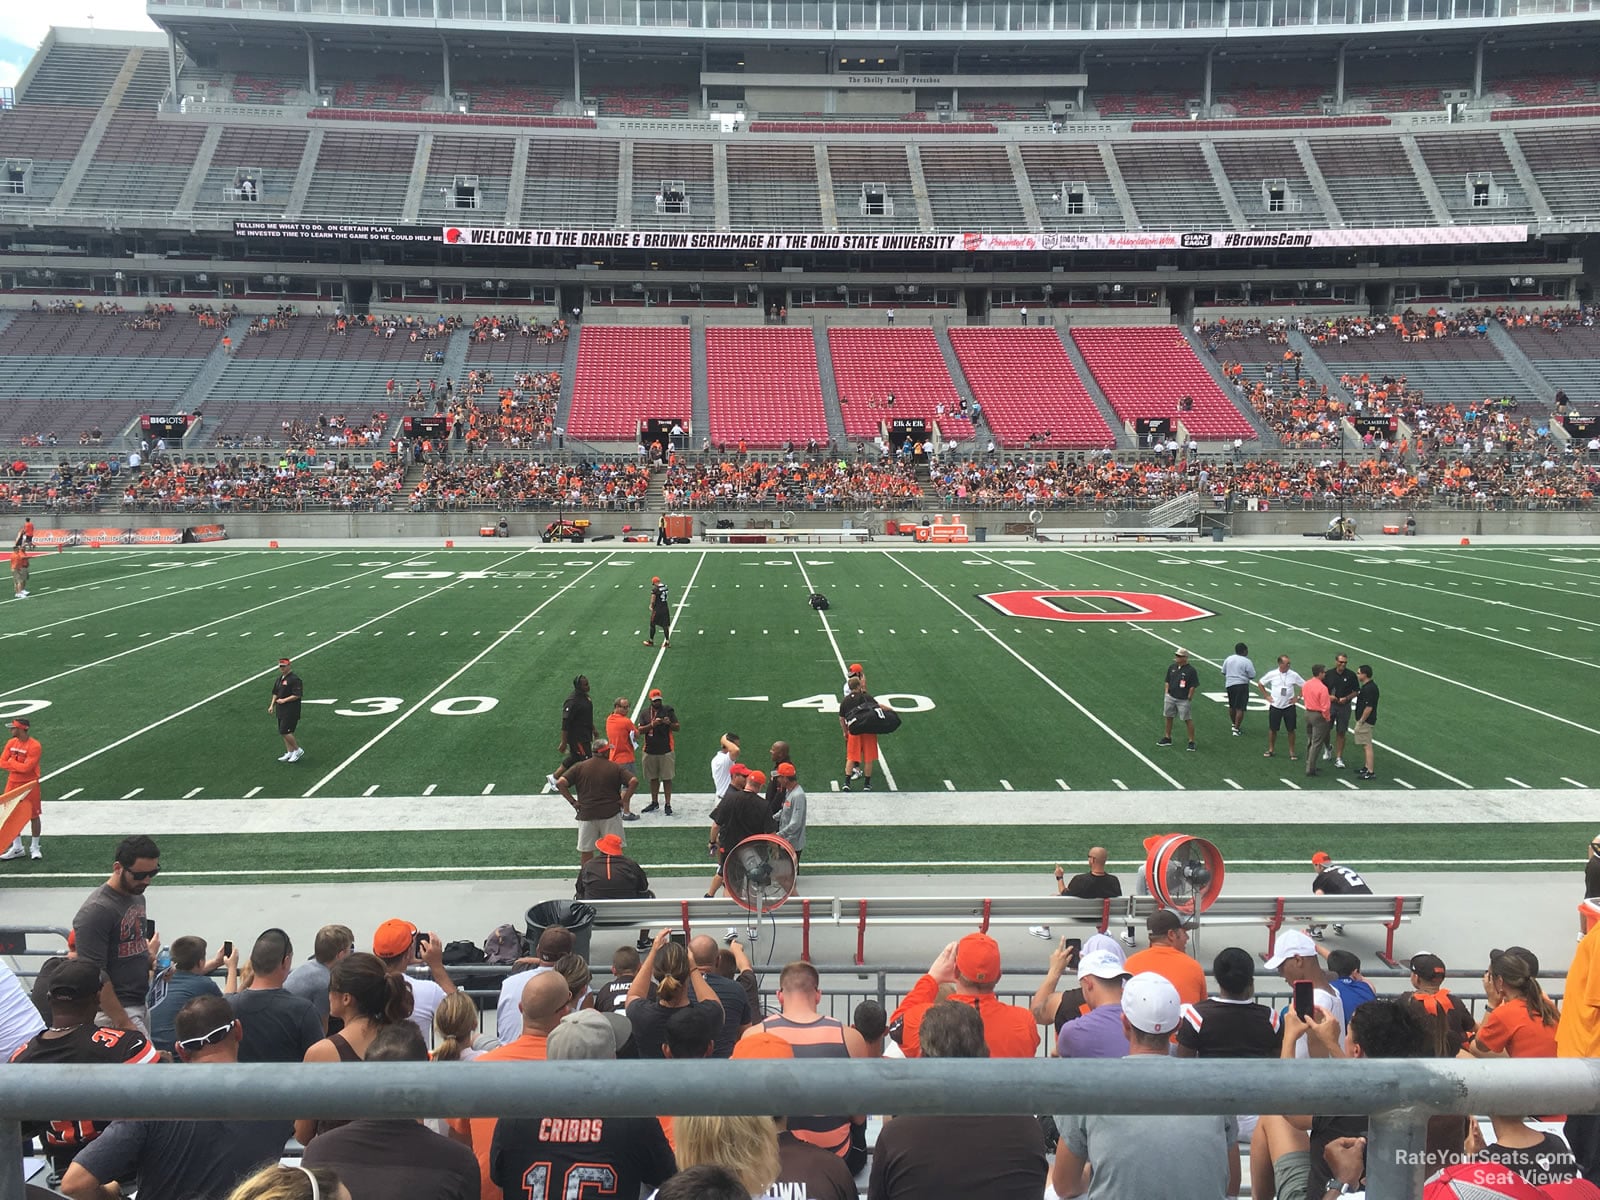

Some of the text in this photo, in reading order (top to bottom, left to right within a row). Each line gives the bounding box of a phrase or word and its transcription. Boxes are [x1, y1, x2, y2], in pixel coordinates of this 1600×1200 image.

[887, 76, 909, 84] Family
[471, 230, 531, 244] WELCOME
[536, 231, 551, 245] TO
[555, 231, 577, 246] THE
[581, 232, 629, 246] ORANGE
[632, 233, 641, 247] &
[643, 233, 688, 247] BROWN
[691, 234, 764, 248] SCRIMMAGE
[766, 235, 782, 249] AT
[786, 235, 807, 249] THE
[810, 235, 840, 249] OHIO
[842, 235, 879, 249] STATE
[882, 235, 955, 249] UNIVERSITY
[1224, 232, 1312, 248] #BrownsCamp
[92, 1027, 125, 1048] 31
[539, 1118, 602, 1143] CRIBBS
